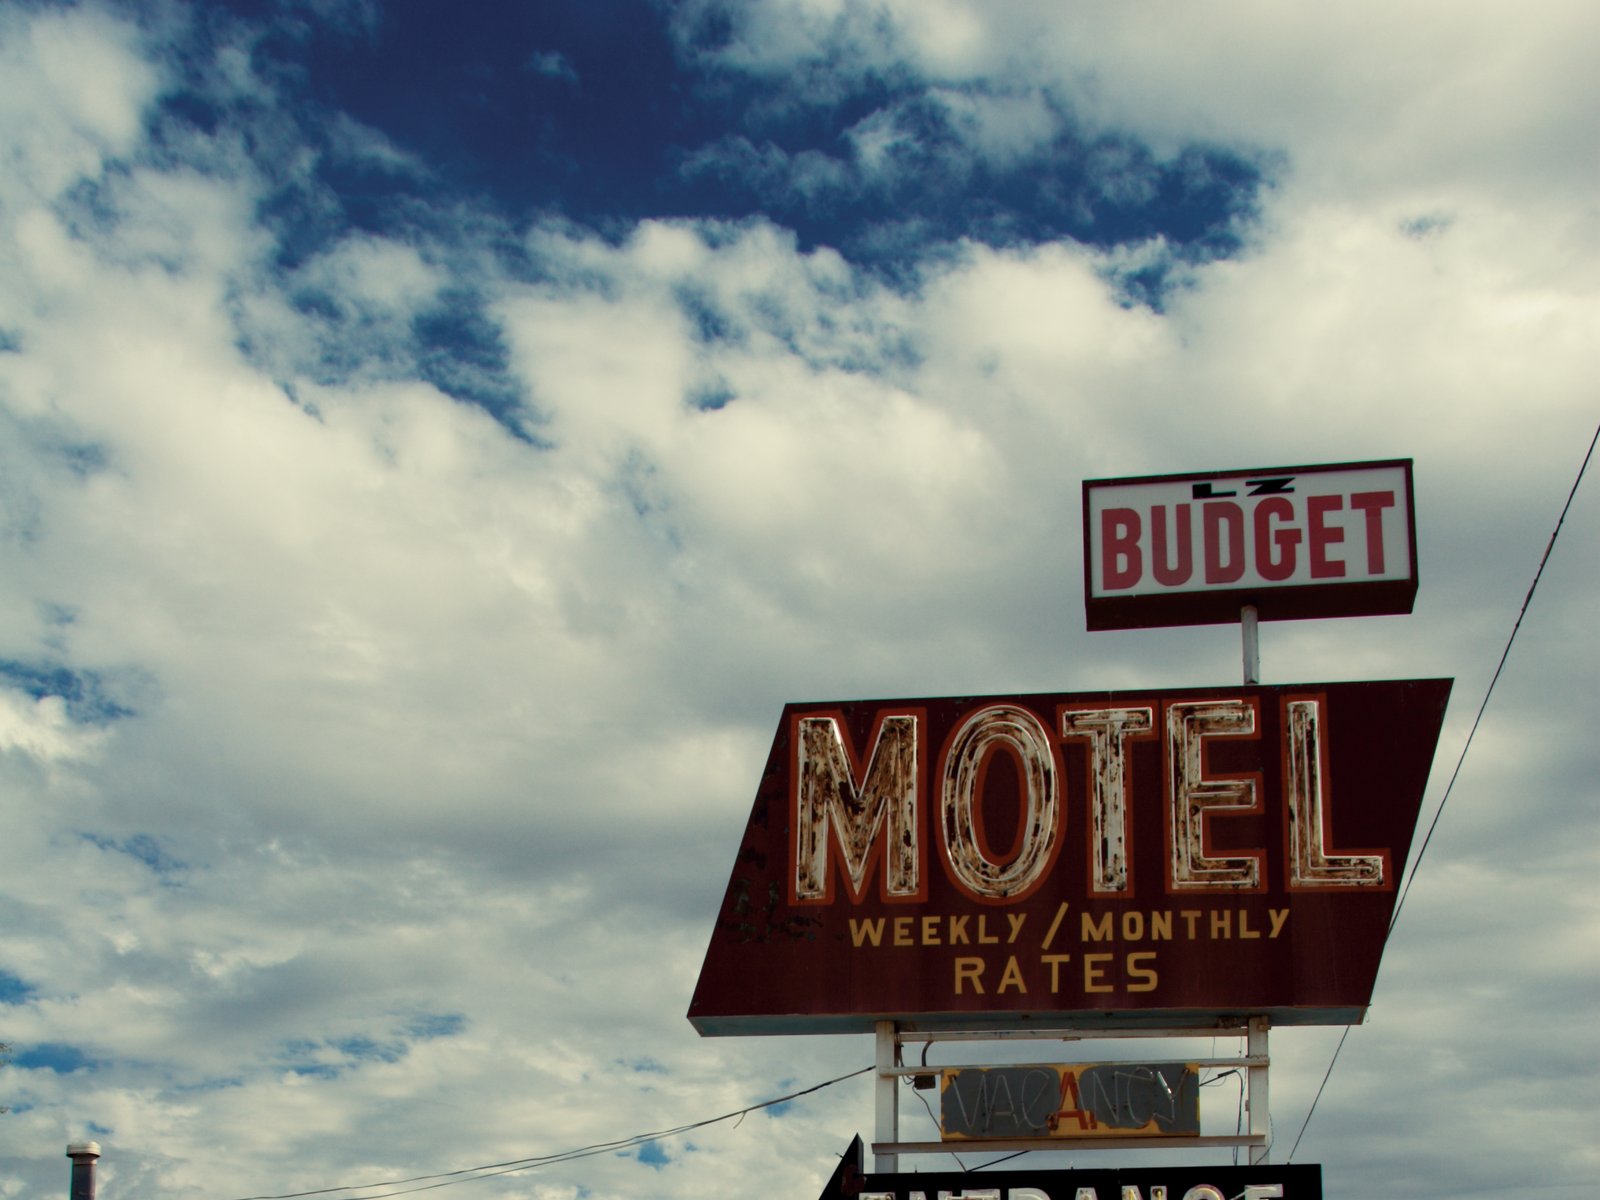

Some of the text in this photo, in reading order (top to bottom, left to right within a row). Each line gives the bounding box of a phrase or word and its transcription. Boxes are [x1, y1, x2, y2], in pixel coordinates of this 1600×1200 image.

[1101, 490, 1395, 591] BUDGET
[796, 700, 1385, 899] MOTEL
[954, 952, 1159, 995] RATES
